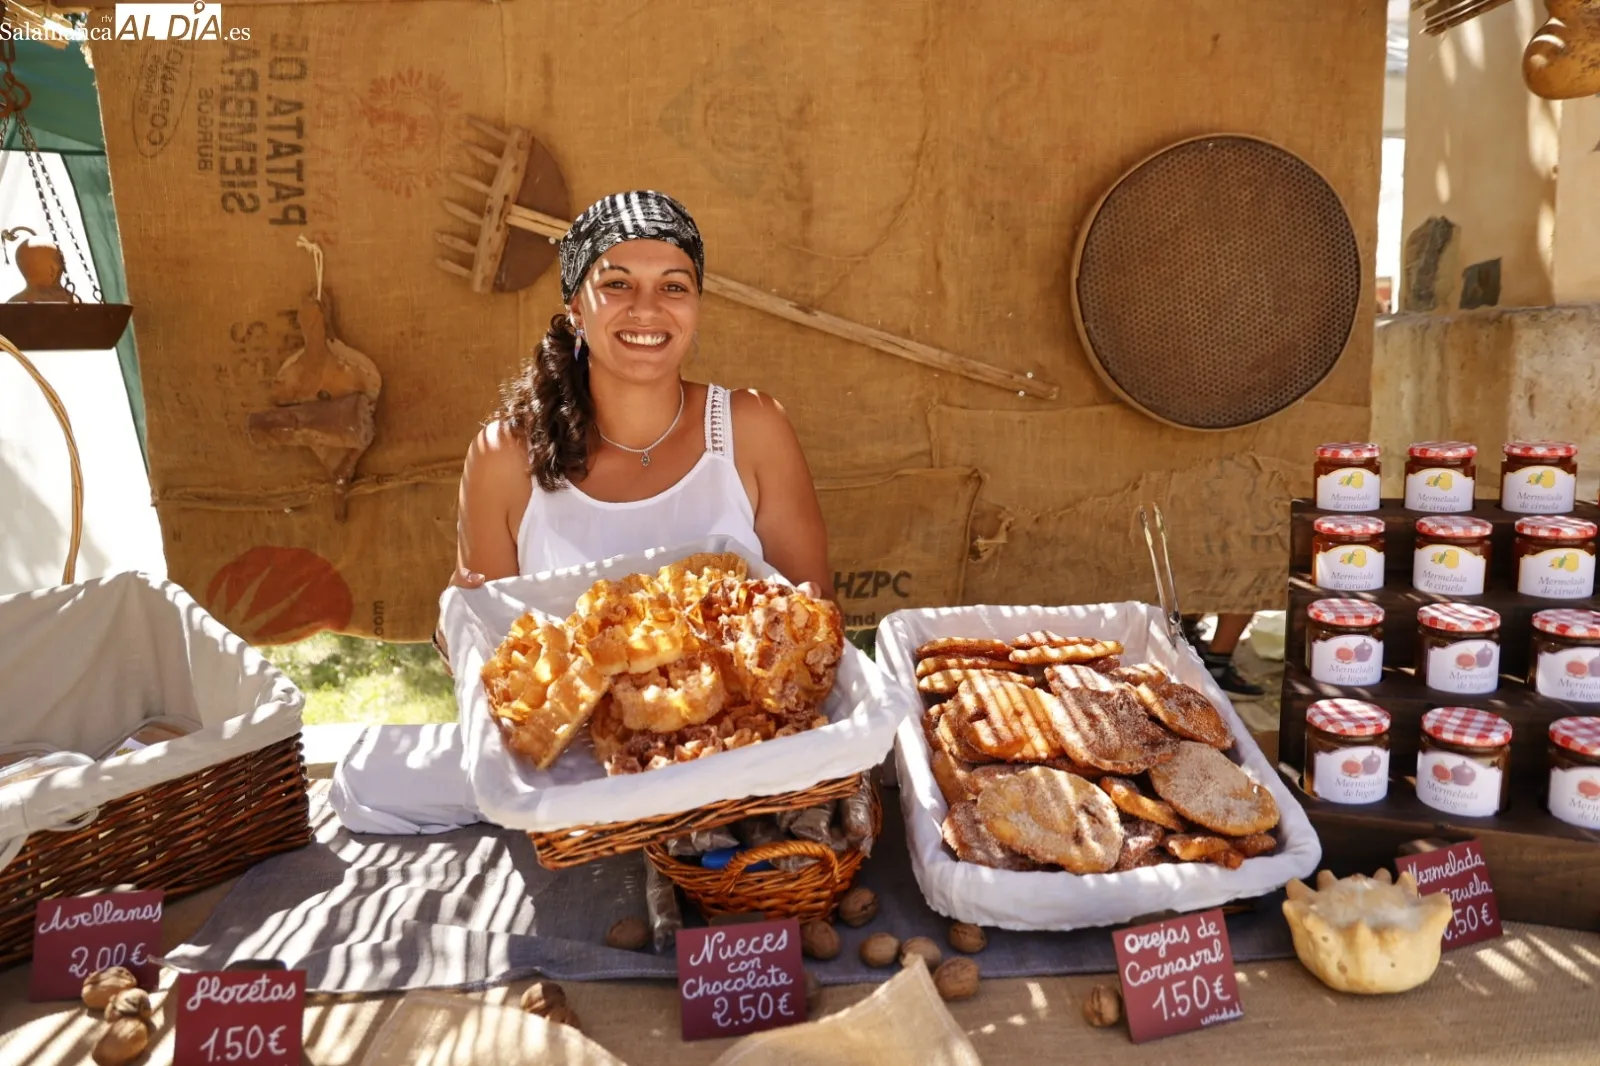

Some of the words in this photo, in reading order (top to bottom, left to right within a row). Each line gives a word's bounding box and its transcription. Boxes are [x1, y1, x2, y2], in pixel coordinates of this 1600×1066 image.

[1418, 502, 1428, 510] de
[1519, 501, 1529, 509] de
[833, 570, 912, 599] HZPC
[1424, 579, 1433, 588] de
[1540, 586, 1550, 594] de
[1336, 674, 1346, 682] de
[38, 900, 162, 934] Avellanas
[1197, 916, 1220, 939] de
[689, 928, 789, 966] Nueces
[727, 957, 762, 973] con
[1125, 939, 1224, 988] Carnaval
[682, 964, 794, 1000] Chocolate
[711, 992, 794, 1027] 2.50€
[1152, 974, 1231, 1022] 1.50€
[1200, 1002, 1244, 1026] unidad
[200, 1024, 287, 1062] 1.50€
